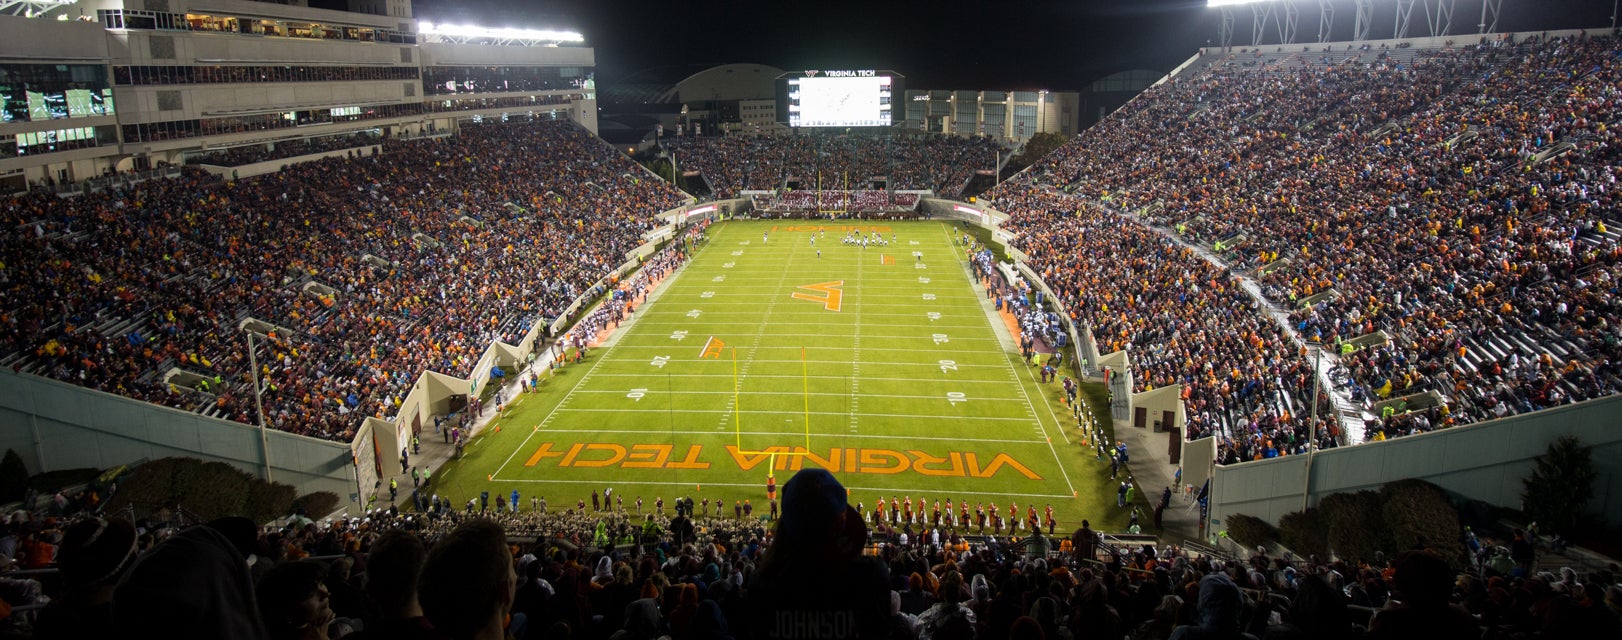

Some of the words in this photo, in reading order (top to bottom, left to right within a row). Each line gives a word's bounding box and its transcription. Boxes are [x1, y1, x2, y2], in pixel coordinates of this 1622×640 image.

[858, 69, 875, 77] TECH
[650, 355, 671, 366] 20
[939, 360, 958, 371] 20
[626, 388, 648, 398] 10
[946, 391, 967, 402] 10
[523, 442, 711, 470] TECH
[724, 444, 1046, 481] VIRGINIA
[769, 609, 860, 640] JOHNSON
